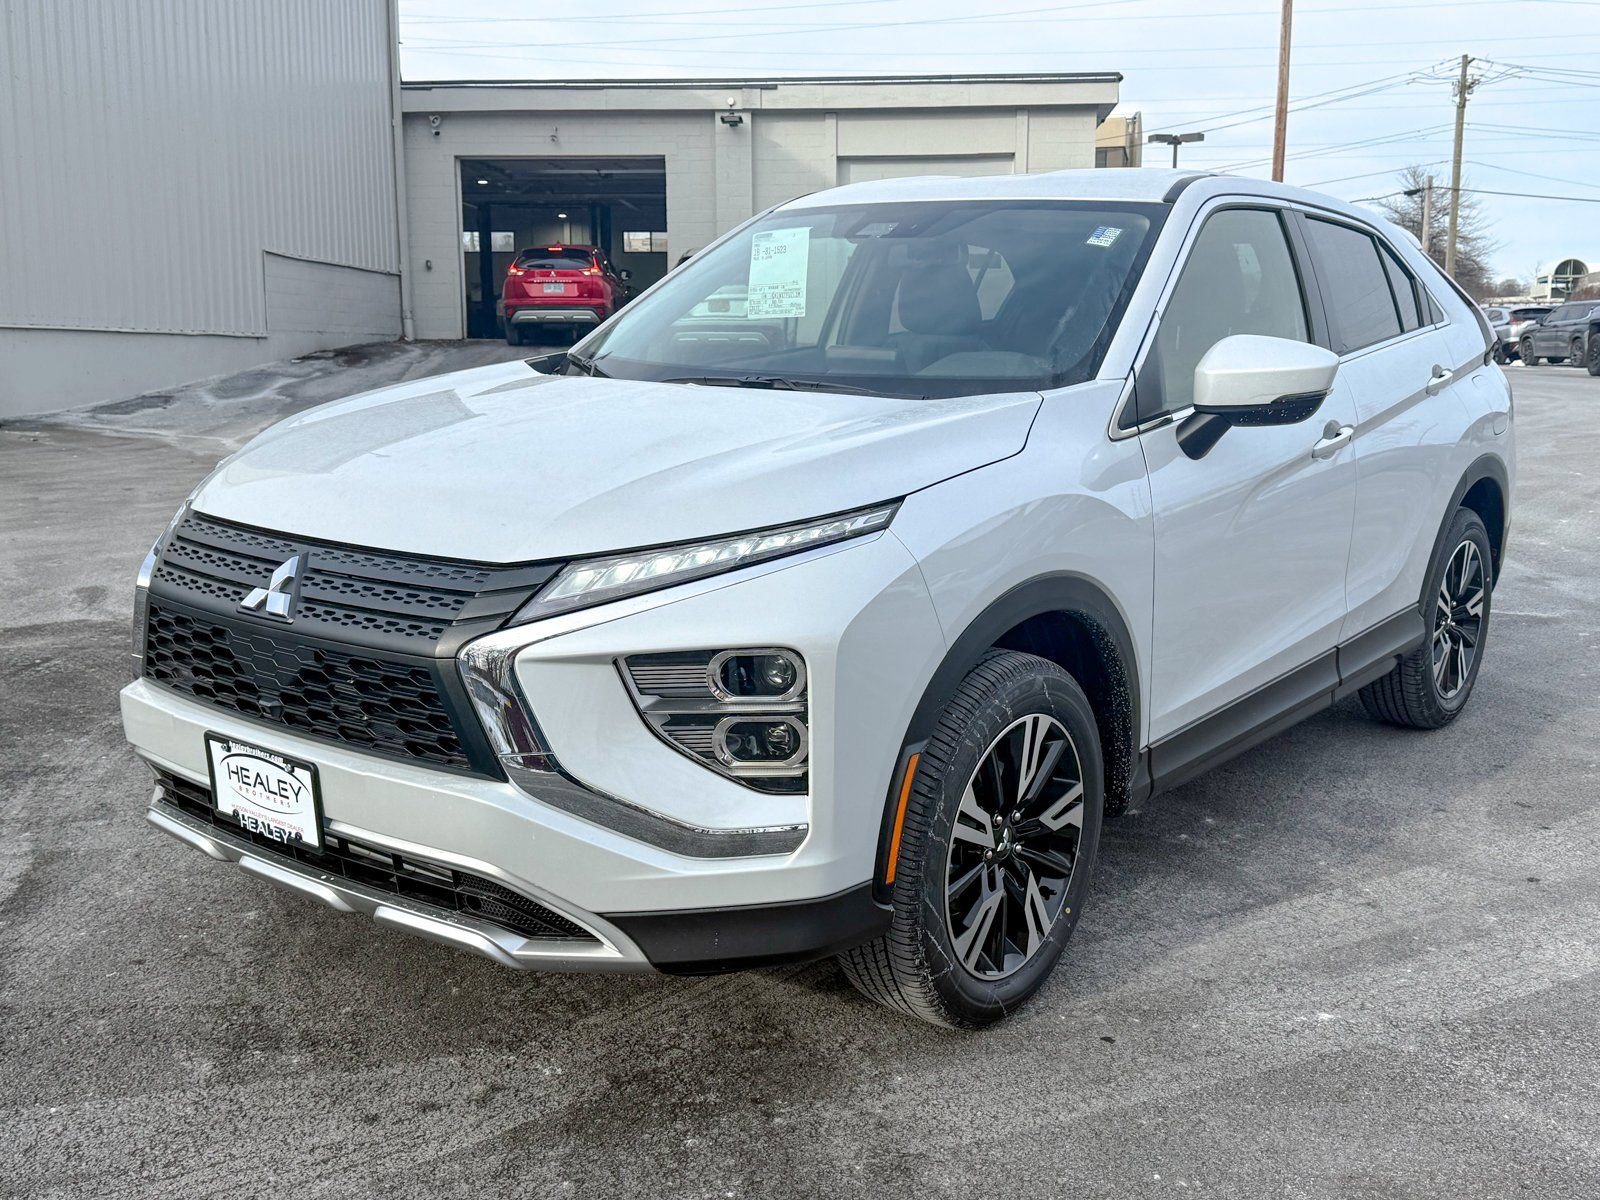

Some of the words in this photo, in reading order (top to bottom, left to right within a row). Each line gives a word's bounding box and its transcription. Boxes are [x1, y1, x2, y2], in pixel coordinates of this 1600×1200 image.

[227, 762, 302, 803] HEALEY
[239, 785, 290, 808] BROTHERS
[240, 814, 290, 844] HEALEY
